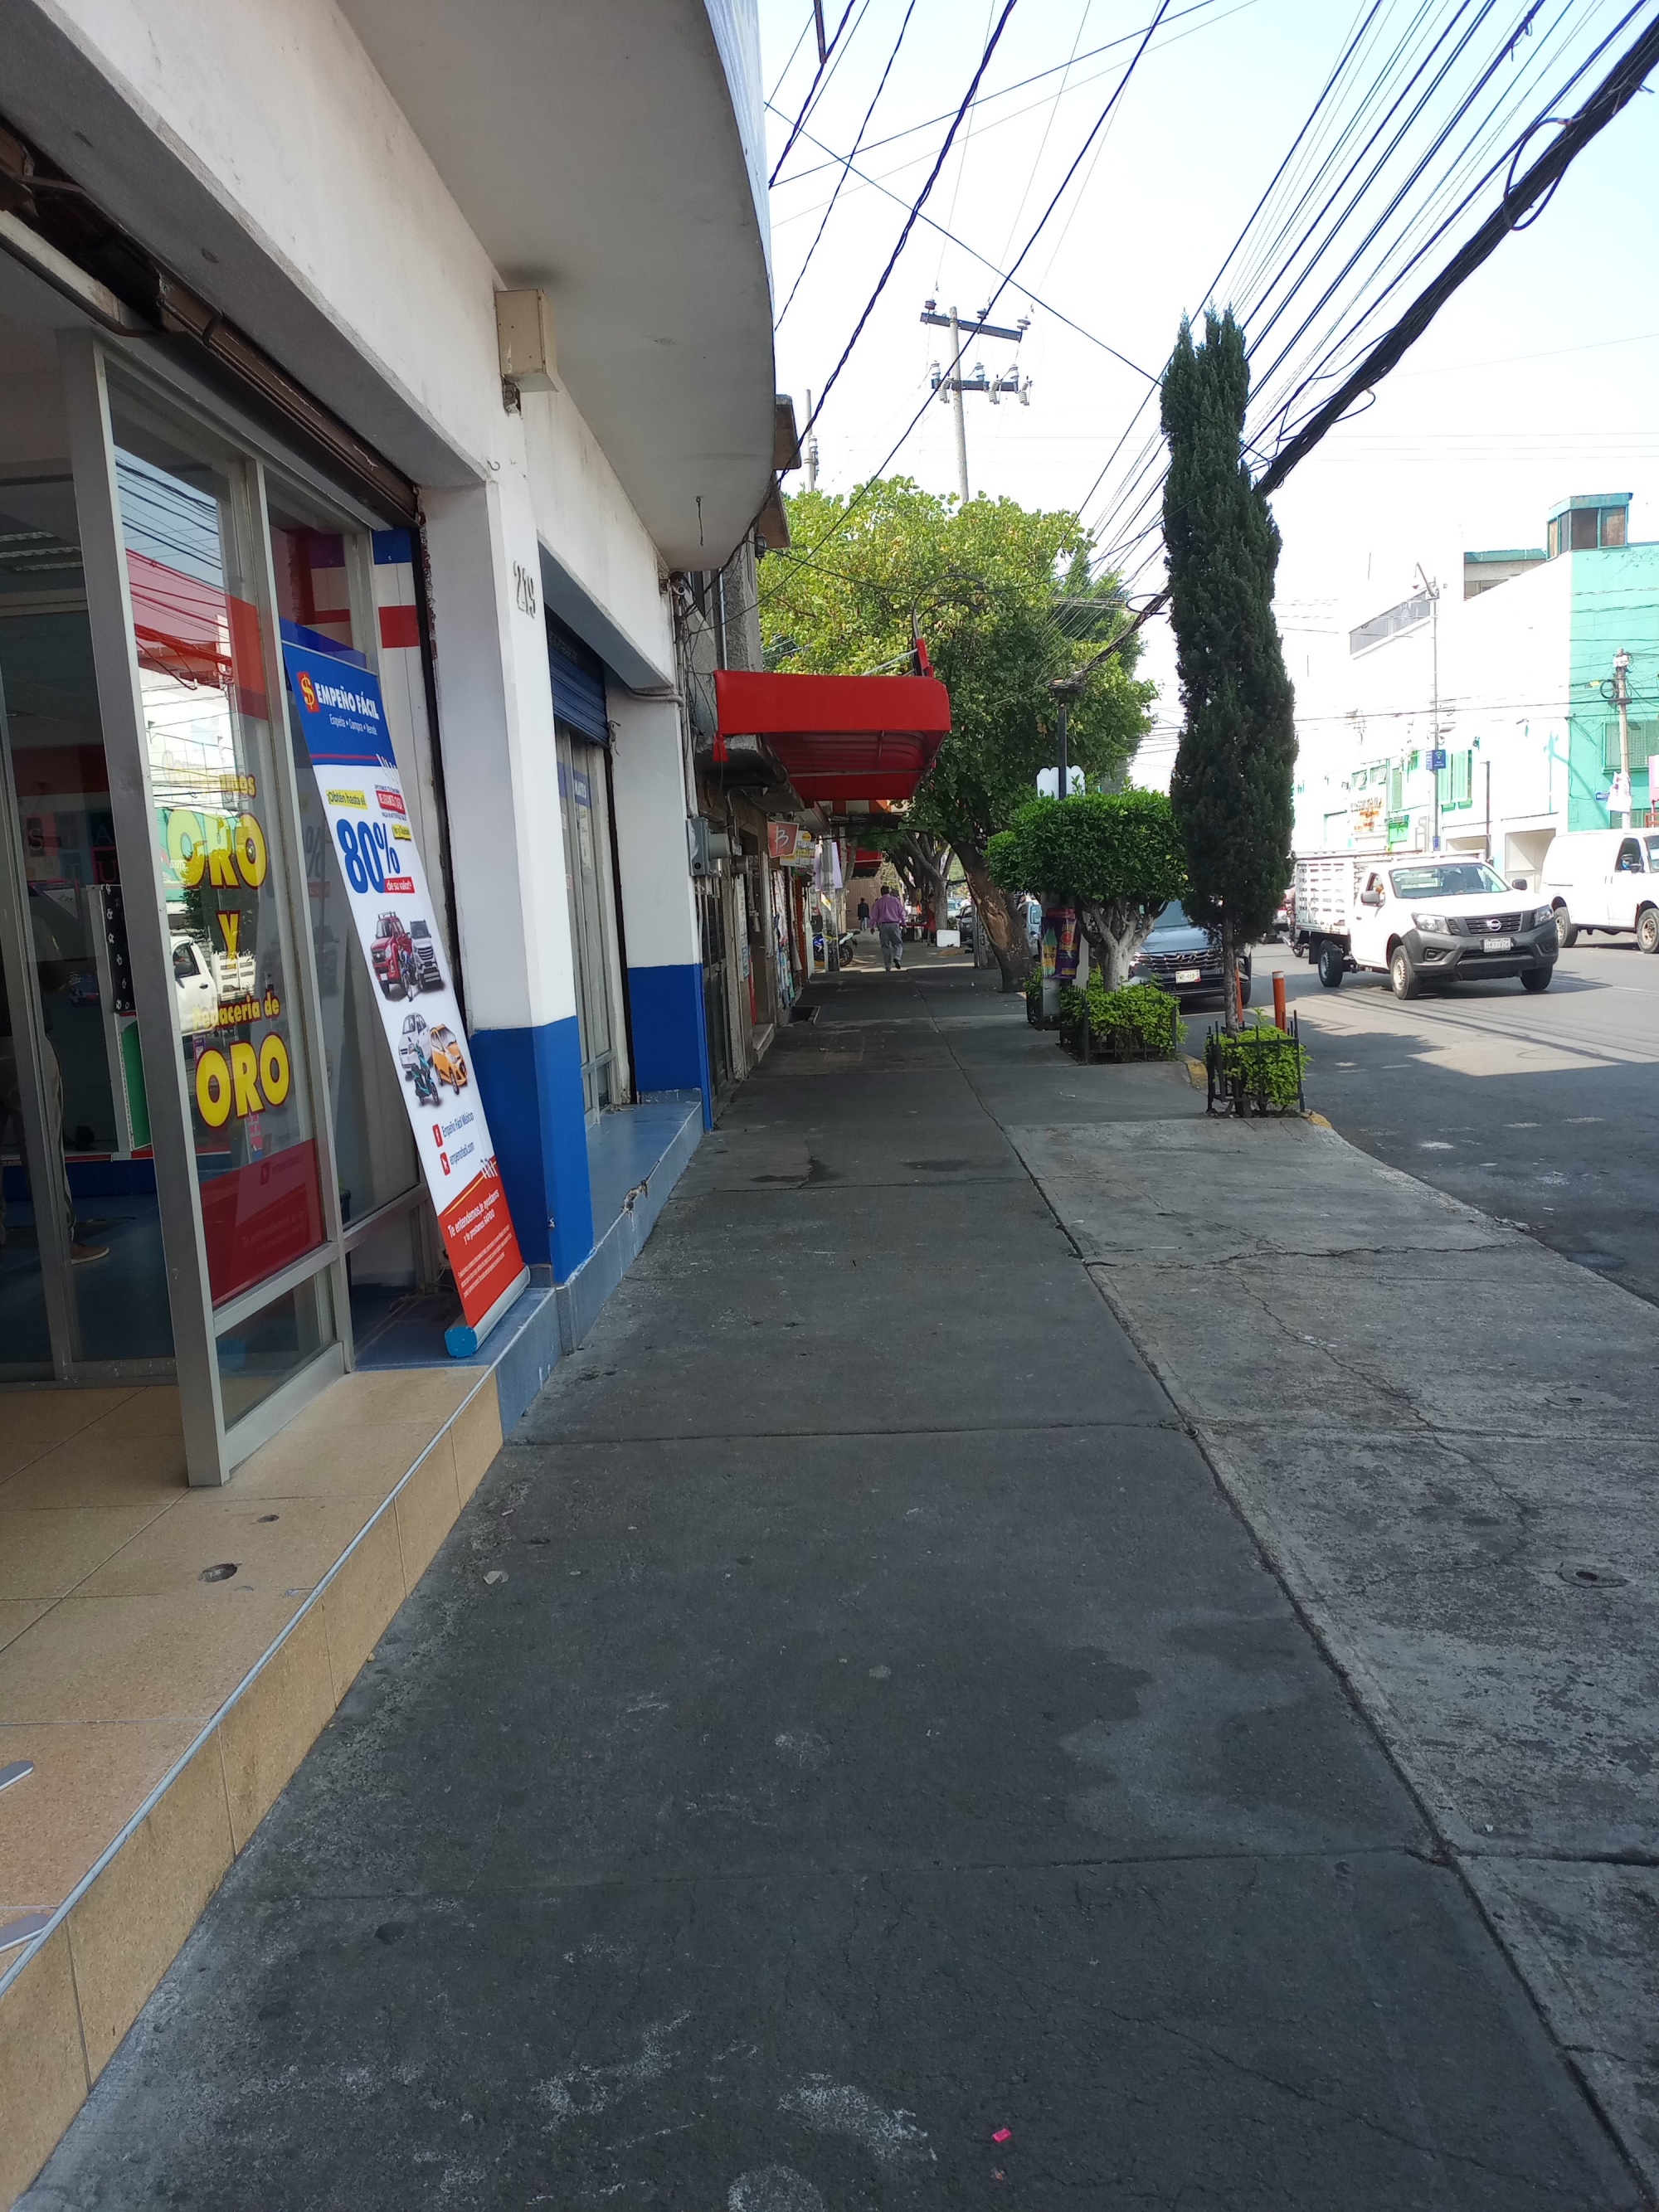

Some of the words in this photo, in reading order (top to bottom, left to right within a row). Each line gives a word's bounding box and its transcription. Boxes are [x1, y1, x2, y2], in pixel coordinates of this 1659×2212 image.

[314, 682, 356, 712] EMPEÑO
[354, 690, 380, 721] FÁCIL
[328, 713, 346, 728] Empeña
[348, 717, 364, 733] Compra
[326, 790, 346, 805] ¡Obtén
[346, 792, 361, 806] hasta
[167, 809, 268, 890] ORO
[336, 818, 401, 894] 80%
[263, 988, 281, 1019] de
[195, 1031, 290, 1129] ORO
[441, 1121, 456, 1137] Empeño
[461, 1111, 474, 1125] México
[447, 1223, 456, 1239] Te
[483, 1189, 500, 1211] ayudamos
[469, 1219, 485, 1241] prestamos
